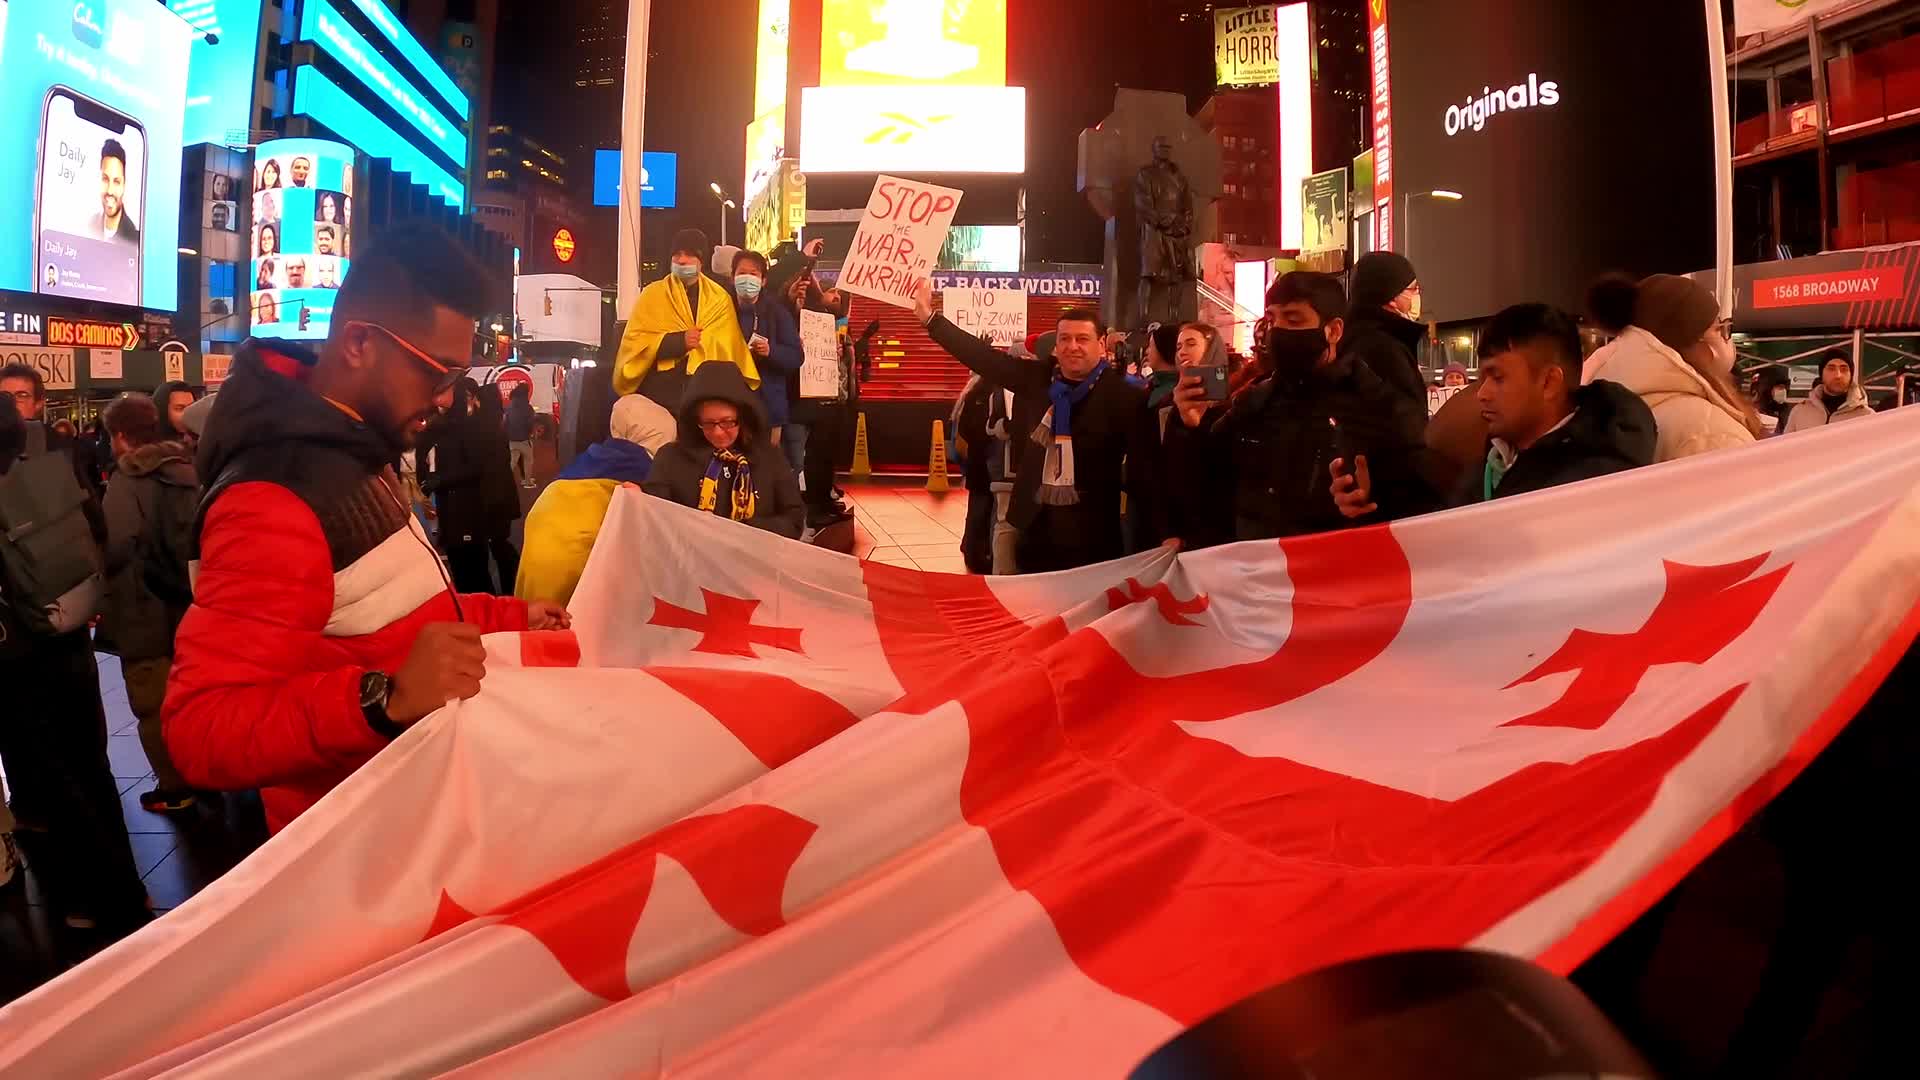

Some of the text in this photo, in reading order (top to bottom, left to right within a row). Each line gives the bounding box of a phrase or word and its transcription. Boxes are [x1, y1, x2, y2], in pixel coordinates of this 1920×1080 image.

[1225, 9, 1271, 34] LITTLE
[1445, 73, 1560, 136] Originals
[59, 141, 86, 168] Daily
[1377, 123, 1389, 185] STORE
[57, 165, 76, 185] Jay
[870, 182, 955, 226] STOP
[893, 223, 912, 236] THE
[44, 240, 78, 261] Daily Jay
[857, 231, 914, 266] WAR
[956, 278, 1012, 289] BACK
[1019, 278, 1100, 295] WORLD!
[1773, 276, 1880, 300] 1568 BROADWAY
[972, 291, 995, 308] NO
[13, 313, 41, 333] FIN
[956, 309, 1023, 327] FLY-ZONE
[50, 321, 123, 347] DOS CAMINOS
